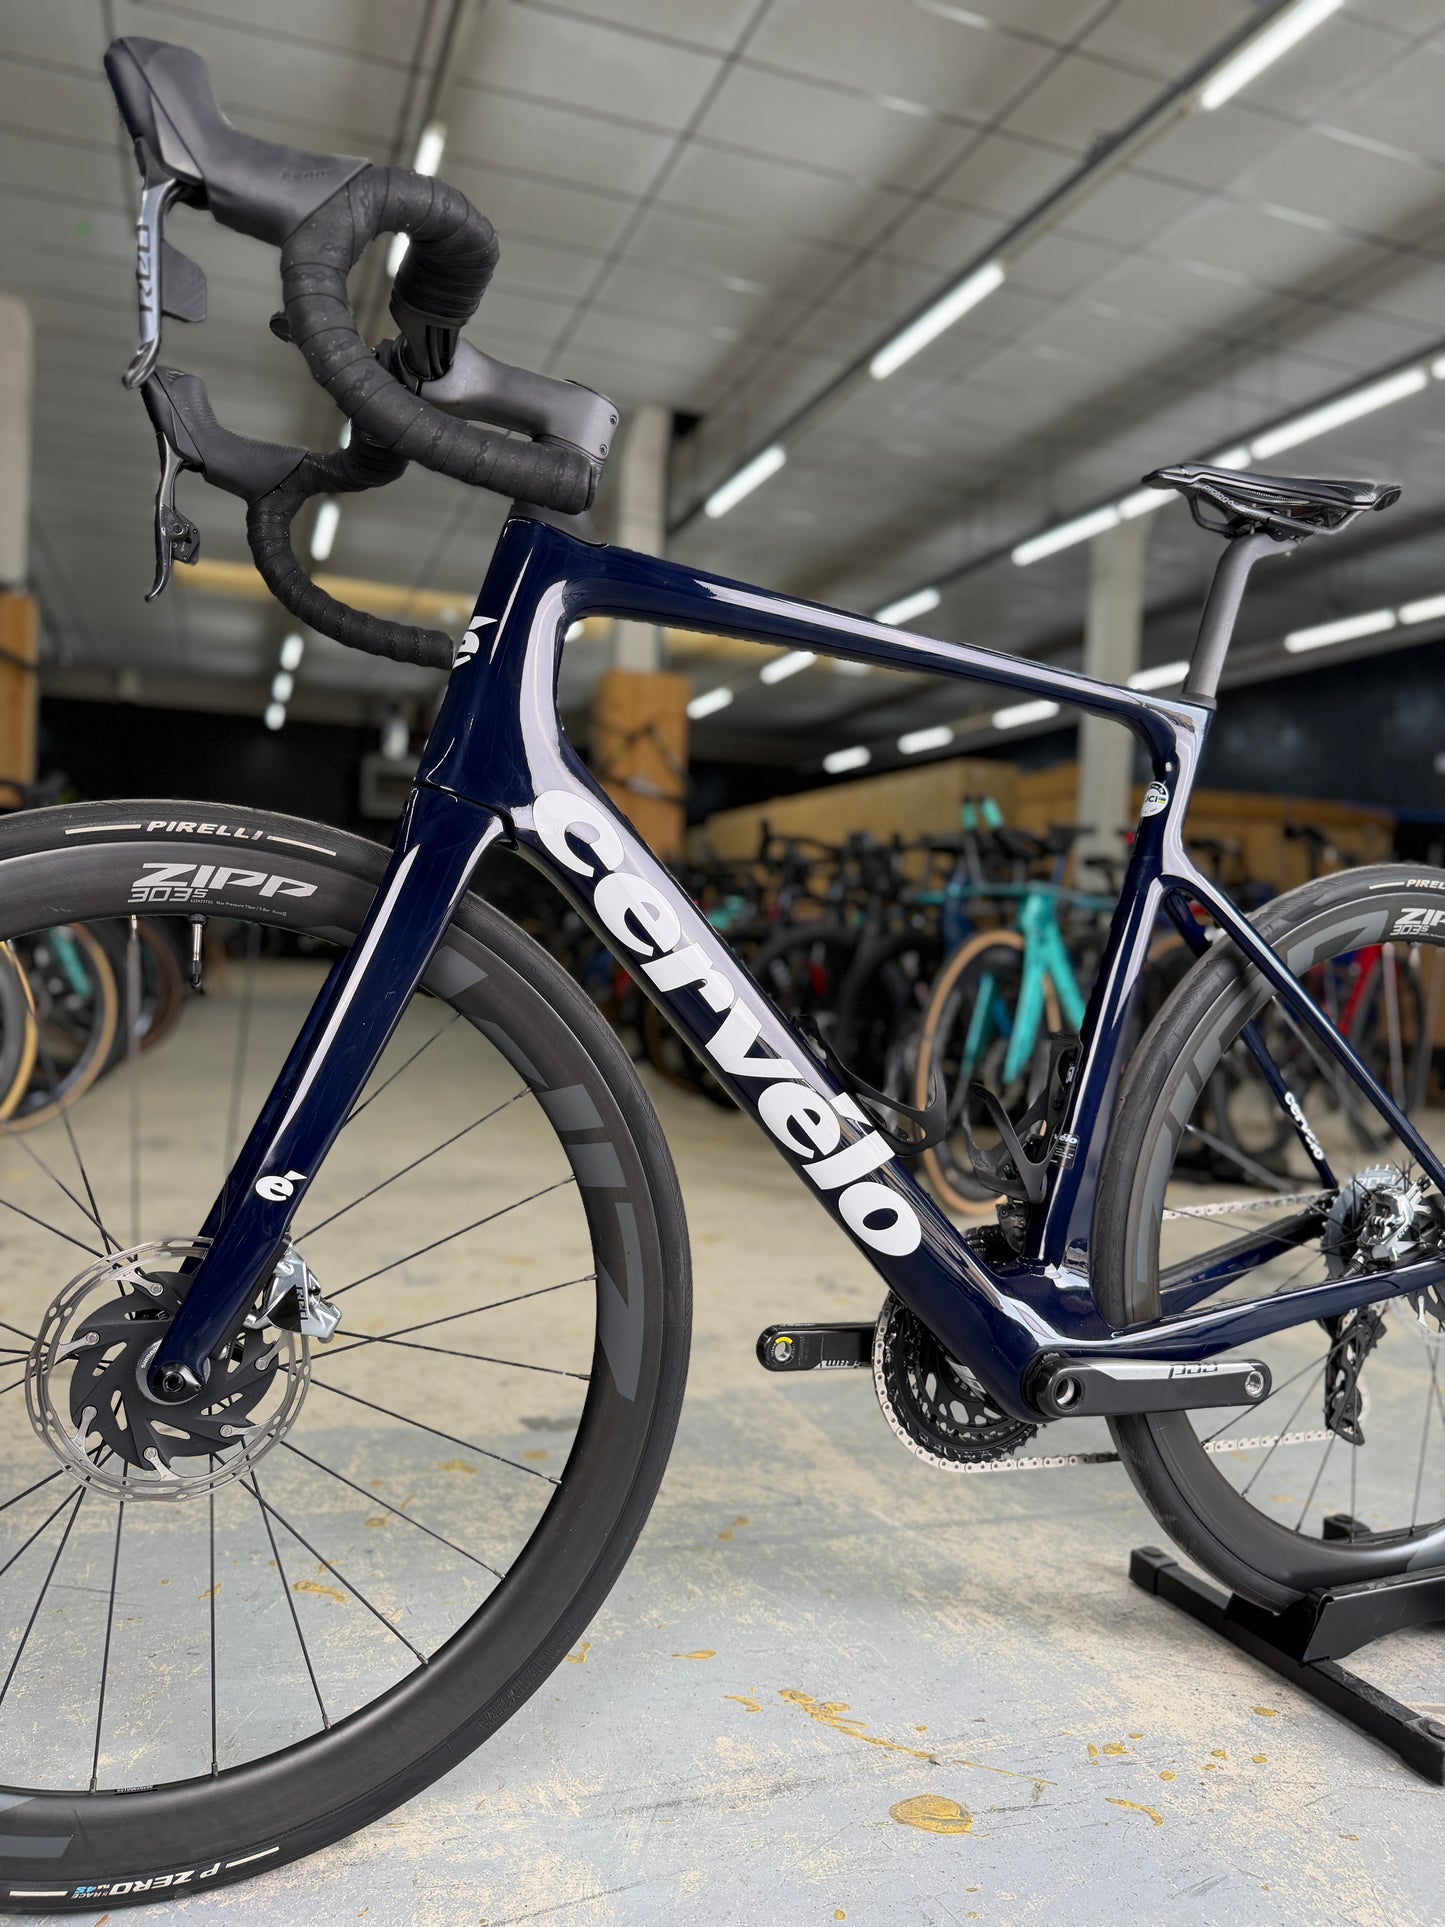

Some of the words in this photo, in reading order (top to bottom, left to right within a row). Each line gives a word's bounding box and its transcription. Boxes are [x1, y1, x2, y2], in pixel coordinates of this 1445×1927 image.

[146, 820, 263, 841] PIRELLI
[132, 862, 319, 898] ZIPP
[532, 789, 922, 1257] cervélo
[109, 1870, 195, 1896] ZERO
[200, 1862, 221, 1879] P
